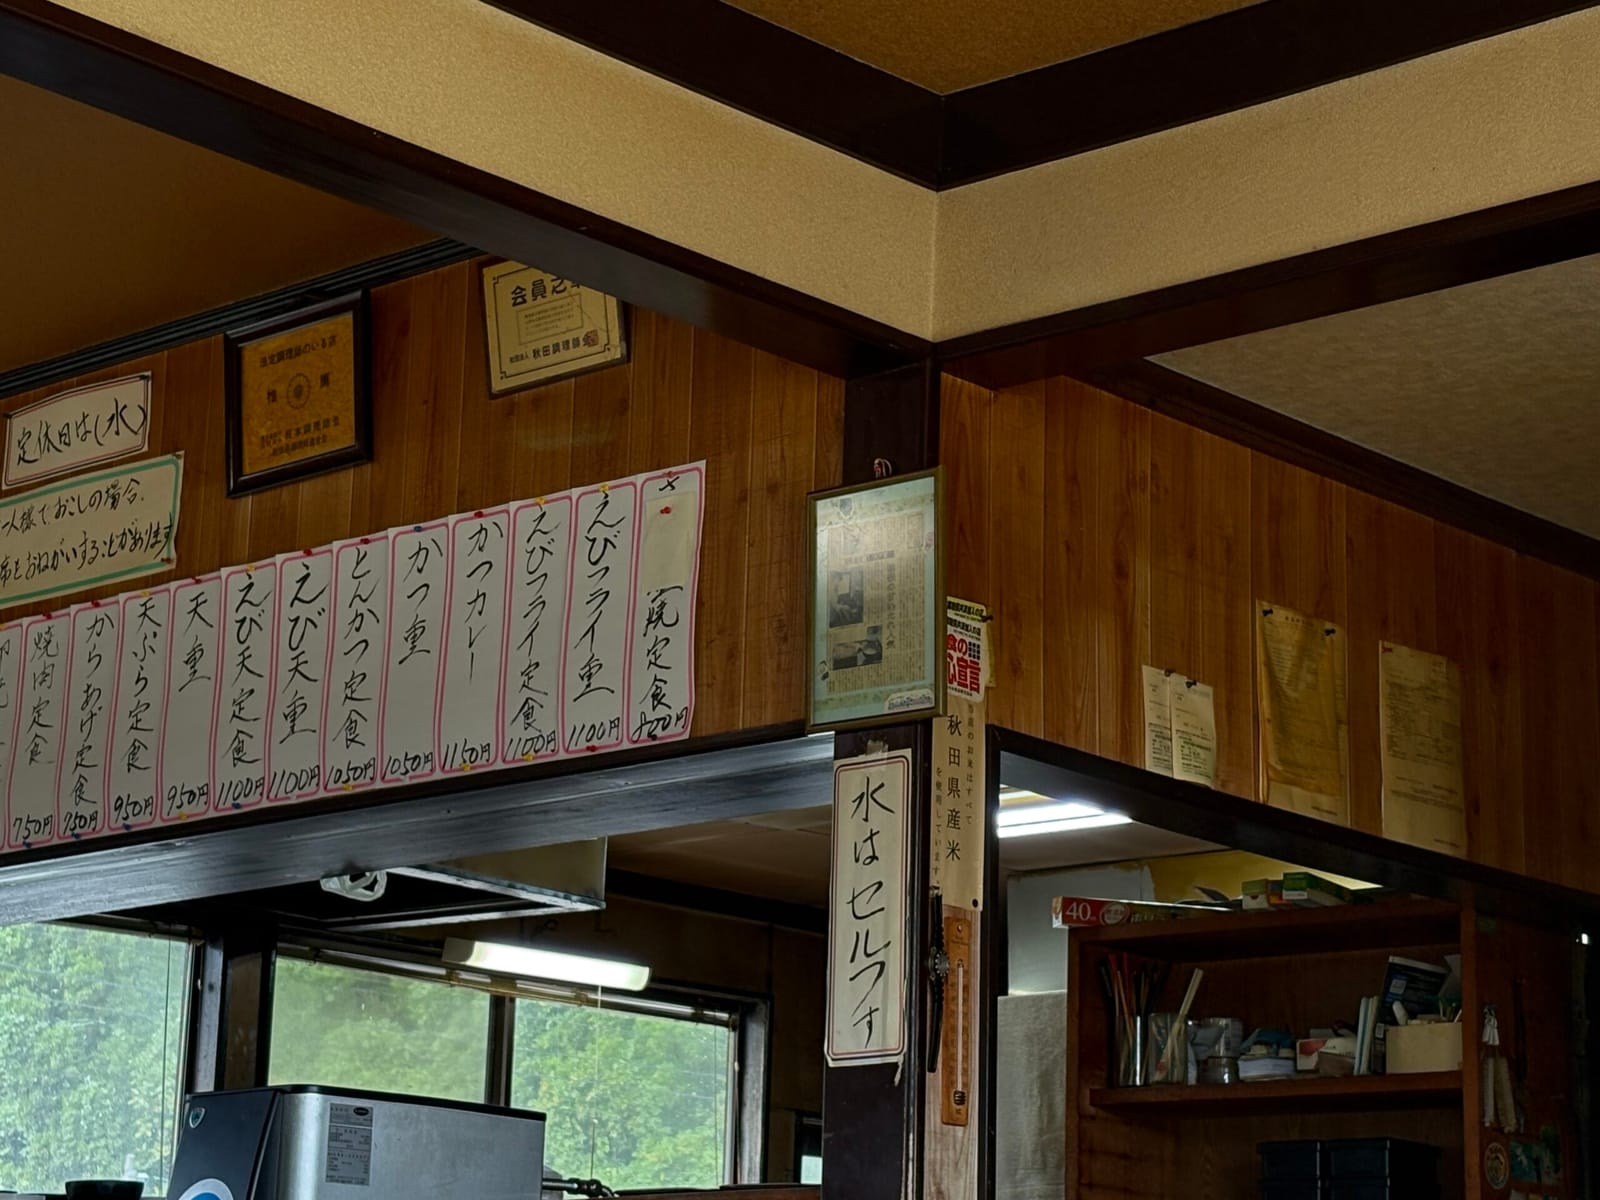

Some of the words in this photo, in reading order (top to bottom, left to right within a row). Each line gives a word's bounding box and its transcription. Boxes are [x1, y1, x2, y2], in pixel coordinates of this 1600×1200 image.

[511, 277, 580, 307] 会員之
[398, 537, 443, 665] かつ重
[467, 521, 503, 685] かつカレー
[510, 505, 561, 733] えびフライ定食
[573, 491, 626, 703] えびフライ重
[178, 591, 214, 692] 天重
[222, 572, 272, 767] えび天定食
[279, 561, 329, 745] えび天重
[332, 547, 383, 749] とんかつ定食
[25, 625, 59, 766] 焼肉定食
[72, 613, 114, 806] からあげ定食
[123, 597, 161, 773] 天ぷら定食
[381, 750, 433, 781] 1050円
[441, 738, 491, 770] 1150円
[503, 730, 556, 761] 1100円
[566, 717, 620, 751] 1100円
[166, 783, 209, 816] 950円
[214, 776, 265, 811] 1100円
[267, 764, 320, 799] 1100円
[325, 757, 376, 790] 1050円
[946, 714, 962, 862] 秋田県産米
[13, 813, 53, 841] 750円
[63, 810, 99, 836] 750円
[113, 795, 154, 828] 950円
